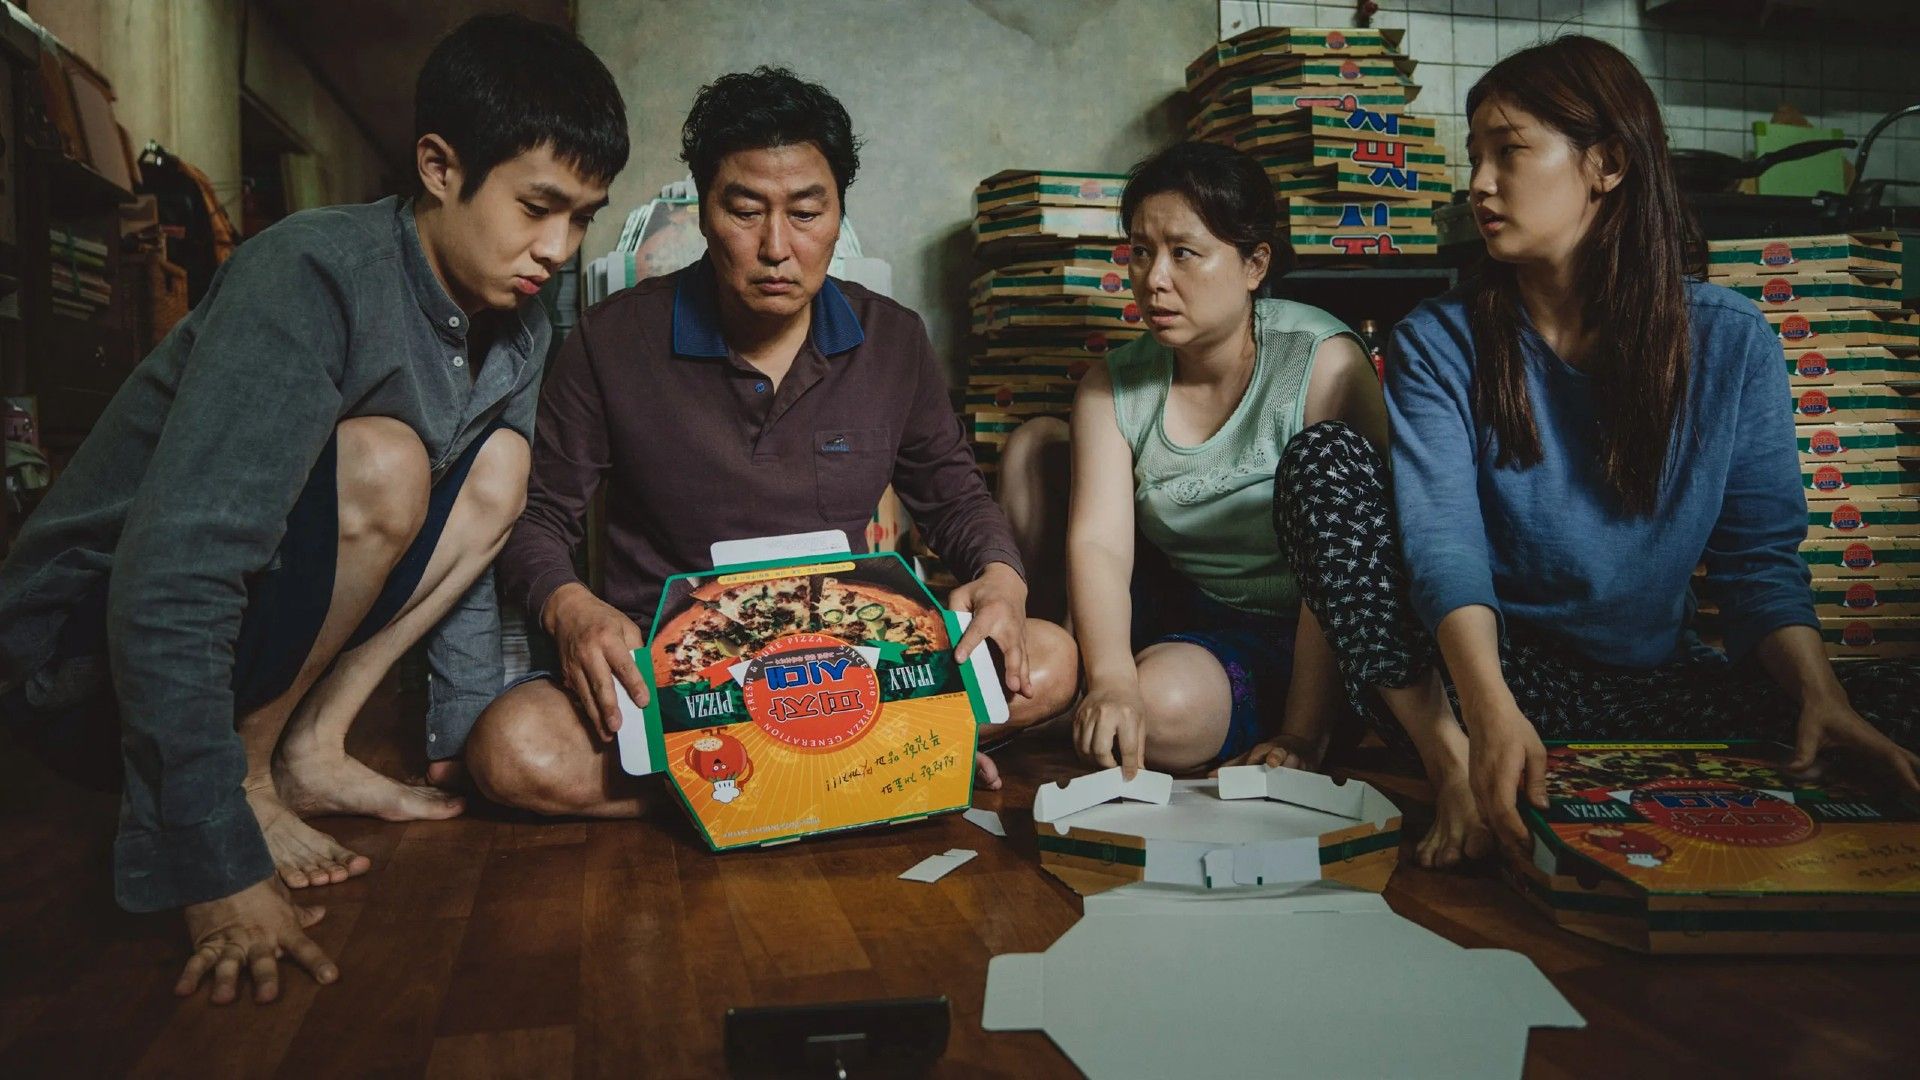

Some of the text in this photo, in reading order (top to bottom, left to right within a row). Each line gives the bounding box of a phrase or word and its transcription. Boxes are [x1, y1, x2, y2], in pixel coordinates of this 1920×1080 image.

[745, 677, 758, 711] FRESH
[756, 642, 784, 663] PURE
[787, 635, 824, 645] PIZZA
[764, 658, 852, 690] 시대
[838, 644, 877, 696] SINCE 2010
[889, 663, 936, 691] ITALY
[685, 690, 734, 719] PIZZA
[768, 689, 864, 723] 피자
[762, 708, 874, 748] PIZZA GENERATION
[920, 754, 955, 781] 신선한
[1562, 803, 1628, 818] PIZZA
